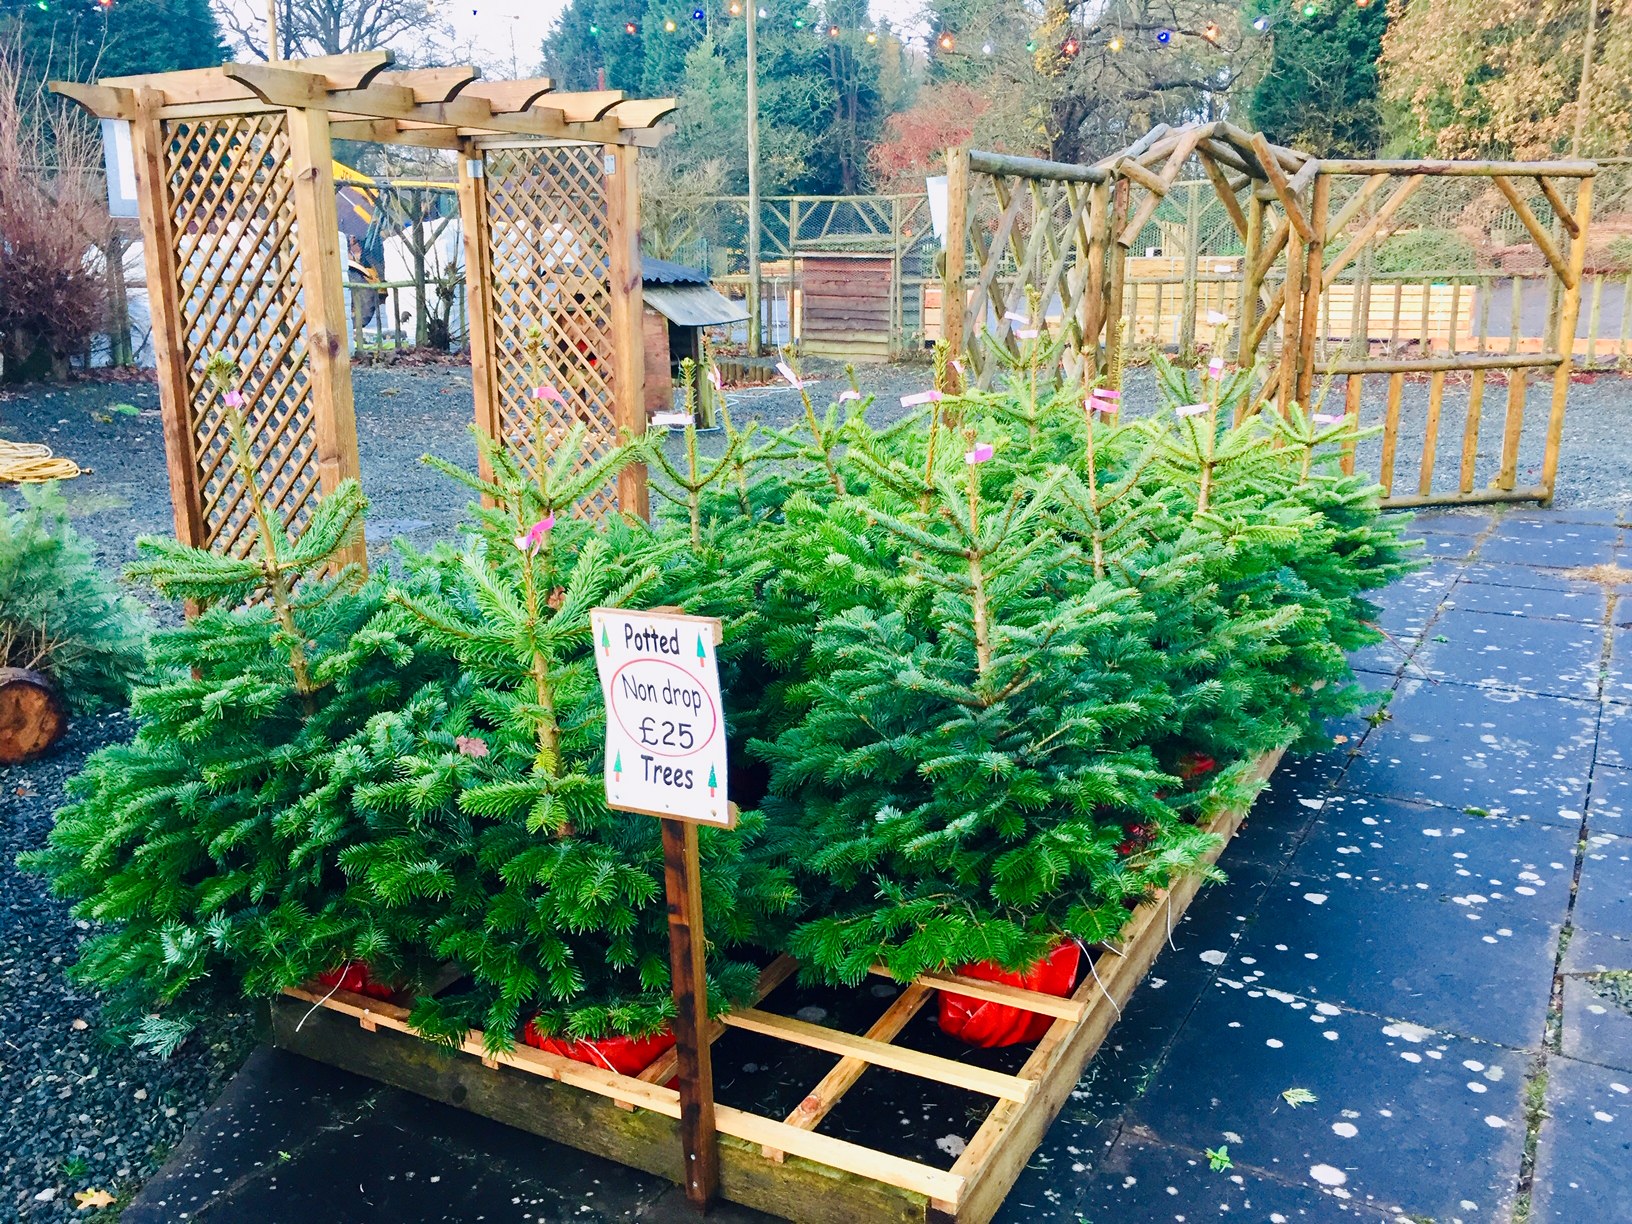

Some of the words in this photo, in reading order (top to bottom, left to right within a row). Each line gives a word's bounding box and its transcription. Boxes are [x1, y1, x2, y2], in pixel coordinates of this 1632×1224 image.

[624, 622, 680, 655] Potted
[621, 673, 658, 704] Non
[662, 678, 702, 717] drop
[638, 716, 694, 750] £25
[640, 754, 694, 790] Trees
